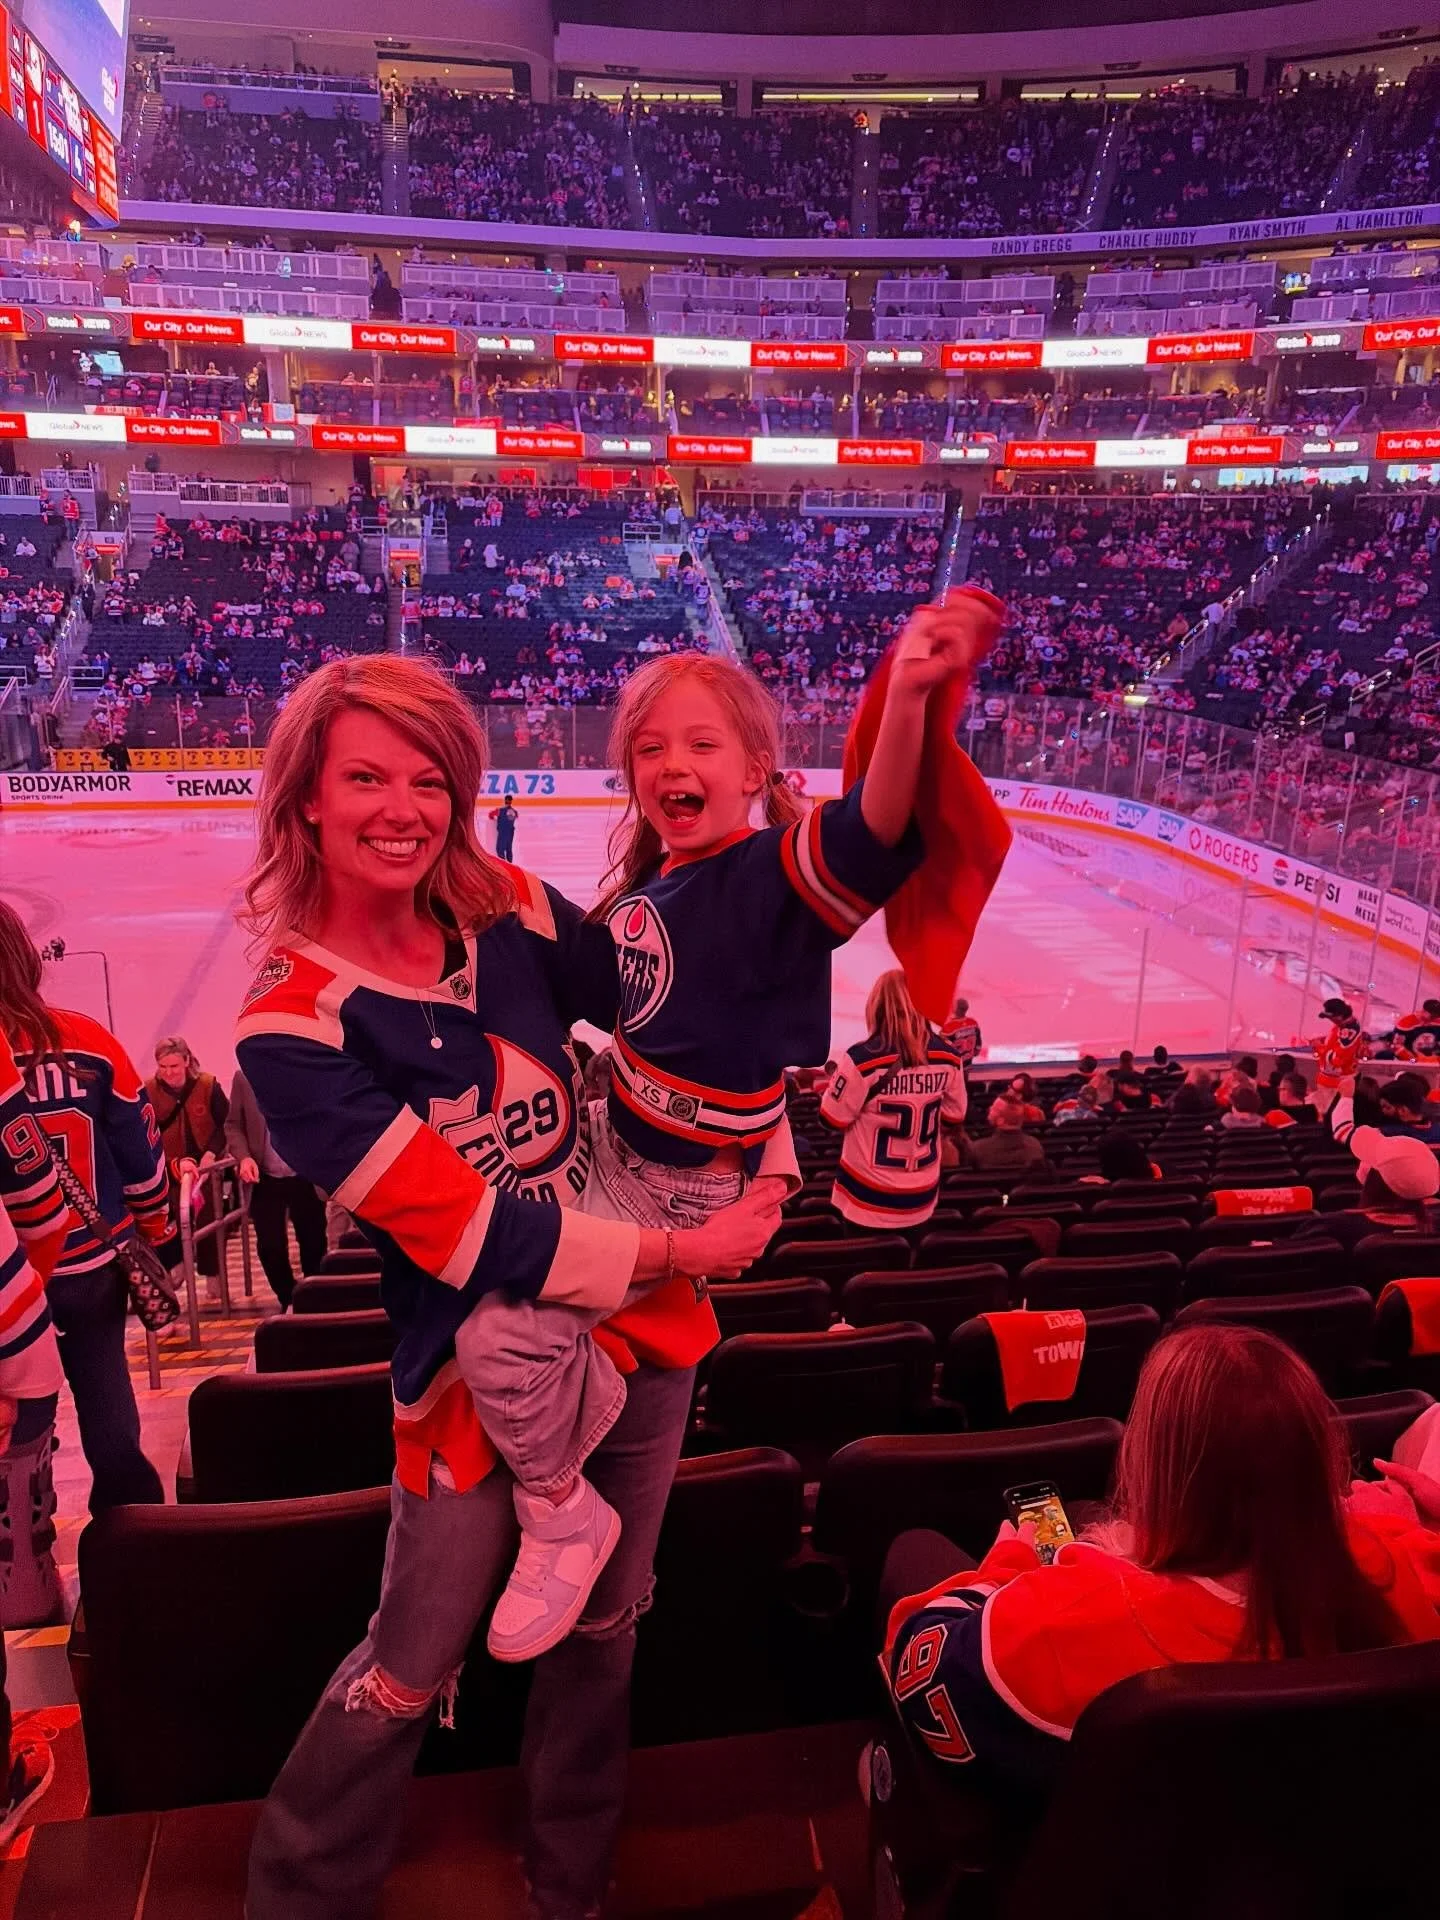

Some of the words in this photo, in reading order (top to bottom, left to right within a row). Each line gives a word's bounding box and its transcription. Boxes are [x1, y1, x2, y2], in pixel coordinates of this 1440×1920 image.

[1336, 214, 1350, 231] AL
[1356, 208, 1425, 229] HAMILTON
[1228, 223, 1260, 241] RYAN
[1263, 220, 1307, 237] SMYTH
[991, 239, 1030, 255] RANDY
[1033, 237, 1072, 253] GREGG
[1099, 233, 1151, 249] CHARLIE
[1155, 231, 1197, 247] HUDDY
[144, 321, 162, 331] Our
[164, 322, 185, 335] City.
[188, 323, 205, 333] Our
[208, 324, 235, 336] News.
[1375, 331, 1392, 342] Our
[1394, 329, 1414, 343] City.
[1416, 327, 1434, 339] Our
[361, 331, 378, 342] Our
[379, 332, 399, 345] City.
[401, 333, 419, 344] Our
[421, 334, 447, 346] News.
[564, 341, 581, 351] Our
[583, 341, 601, 354] City.
[602, 342, 618, 353] Our
[620, 343, 647, 355] News.
[1156, 344, 1172, 355] Our
[1173, 343, 1194, 357] City.
[1195, 342, 1212, 353] Our
[1214, 341, 1243, 352] News.
[757, 350, 773, 360] Our
[774, 350, 791, 363] City.
[793, 351, 810, 361] Our
[811, 351, 837, 362] News.
[951, 351, 968, 362] Our
[969, 351, 989, 364] City.
[990, 350, 1006, 361] Our
[1007, 350, 1033, 361] News.
[132, 424, 148, 434] Our
[150, 424, 170, 437] City.
[171, 425, 186, 435] Our
[188, 426, 213, 437] News.
[322, 431, 338, 441] Our
[340, 431, 358, 444] City.
[359, 432, 375, 442] Our
[376, 433, 399, 443] News.
[503, 437, 520, 447] Our
[521, 437, 538, 449] City.
[538, 438, 554, 448] Our
[555, 439, 577, 449] News.
[675, 442, 691, 452] Our
[692, 442, 709, 454] City.
[709, 443, 724, 453] Our
[725, 444, 746, 454] News.
[1194, 446, 1210, 456] Our
[1211, 445, 1229, 458] City.
[1230, 444, 1246, 455] Our
[1247, 443, 1273, 455] News.
[1386, 437, 1404, 449] Our
[1405, 436, 1423, 449] City.
[843, 446, 858, 456] Our
[859, 446, 876, 458] City.
[876, 447, 891, 457] Our
[892, 447, 914, 457] News.
[1014, 448, 1030, 458] Our
[1031, 448, 1048, 460] City.
[1048, 447, 1064, 458] Our
[1065, 447, 1090, 458] News.
[8, 775, 131, 792] BODYARMOR
[177, 778, 253, 796] REMAX
[480, 774, 519, 794] ZA
[524, 774, 555, 795] 73
[1019, 787, 1048, 809] Tim
[1051, 791, 1110, 821] Hortons
[1118, 804, 1143, 826] SAP
[1203, 834, 1259, 874] ROGERS
[641, 1080, 661, 1104] XS
[830, 1074, 848, 1102] 9
[502, 1088, 560, 1149] 29
[873, 1099, 943, 1170] 29
[1, 1113, 49, 1175] 9
